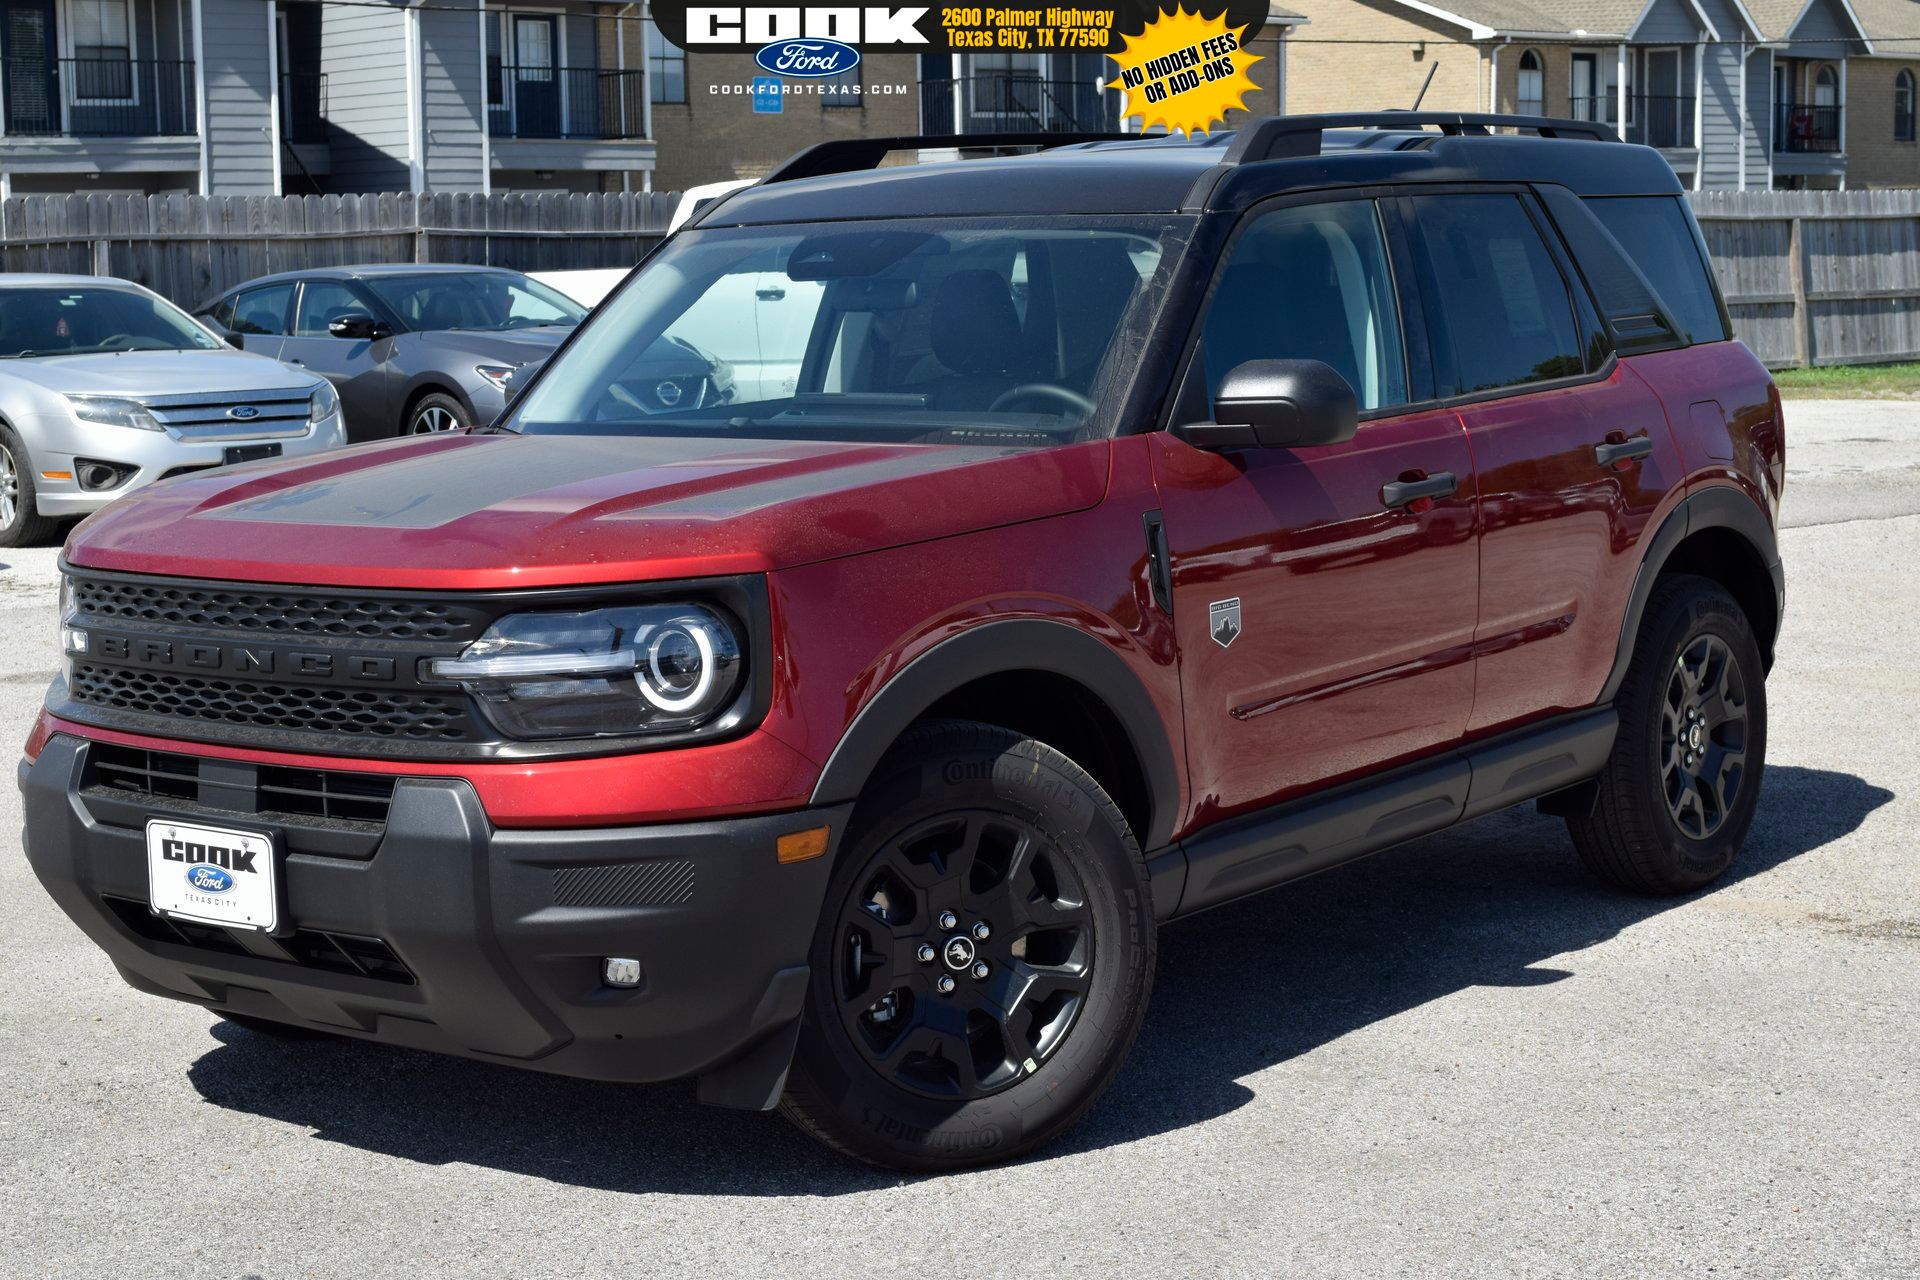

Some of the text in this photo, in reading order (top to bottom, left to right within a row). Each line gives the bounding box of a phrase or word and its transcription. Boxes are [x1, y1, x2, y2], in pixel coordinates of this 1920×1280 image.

[1222, 601, 1239, 609] BEND
[99, 636, 396, 679] BRONCO
[162, 839, 258, 874] COOK
[194, 868, 224, 890] Ford
